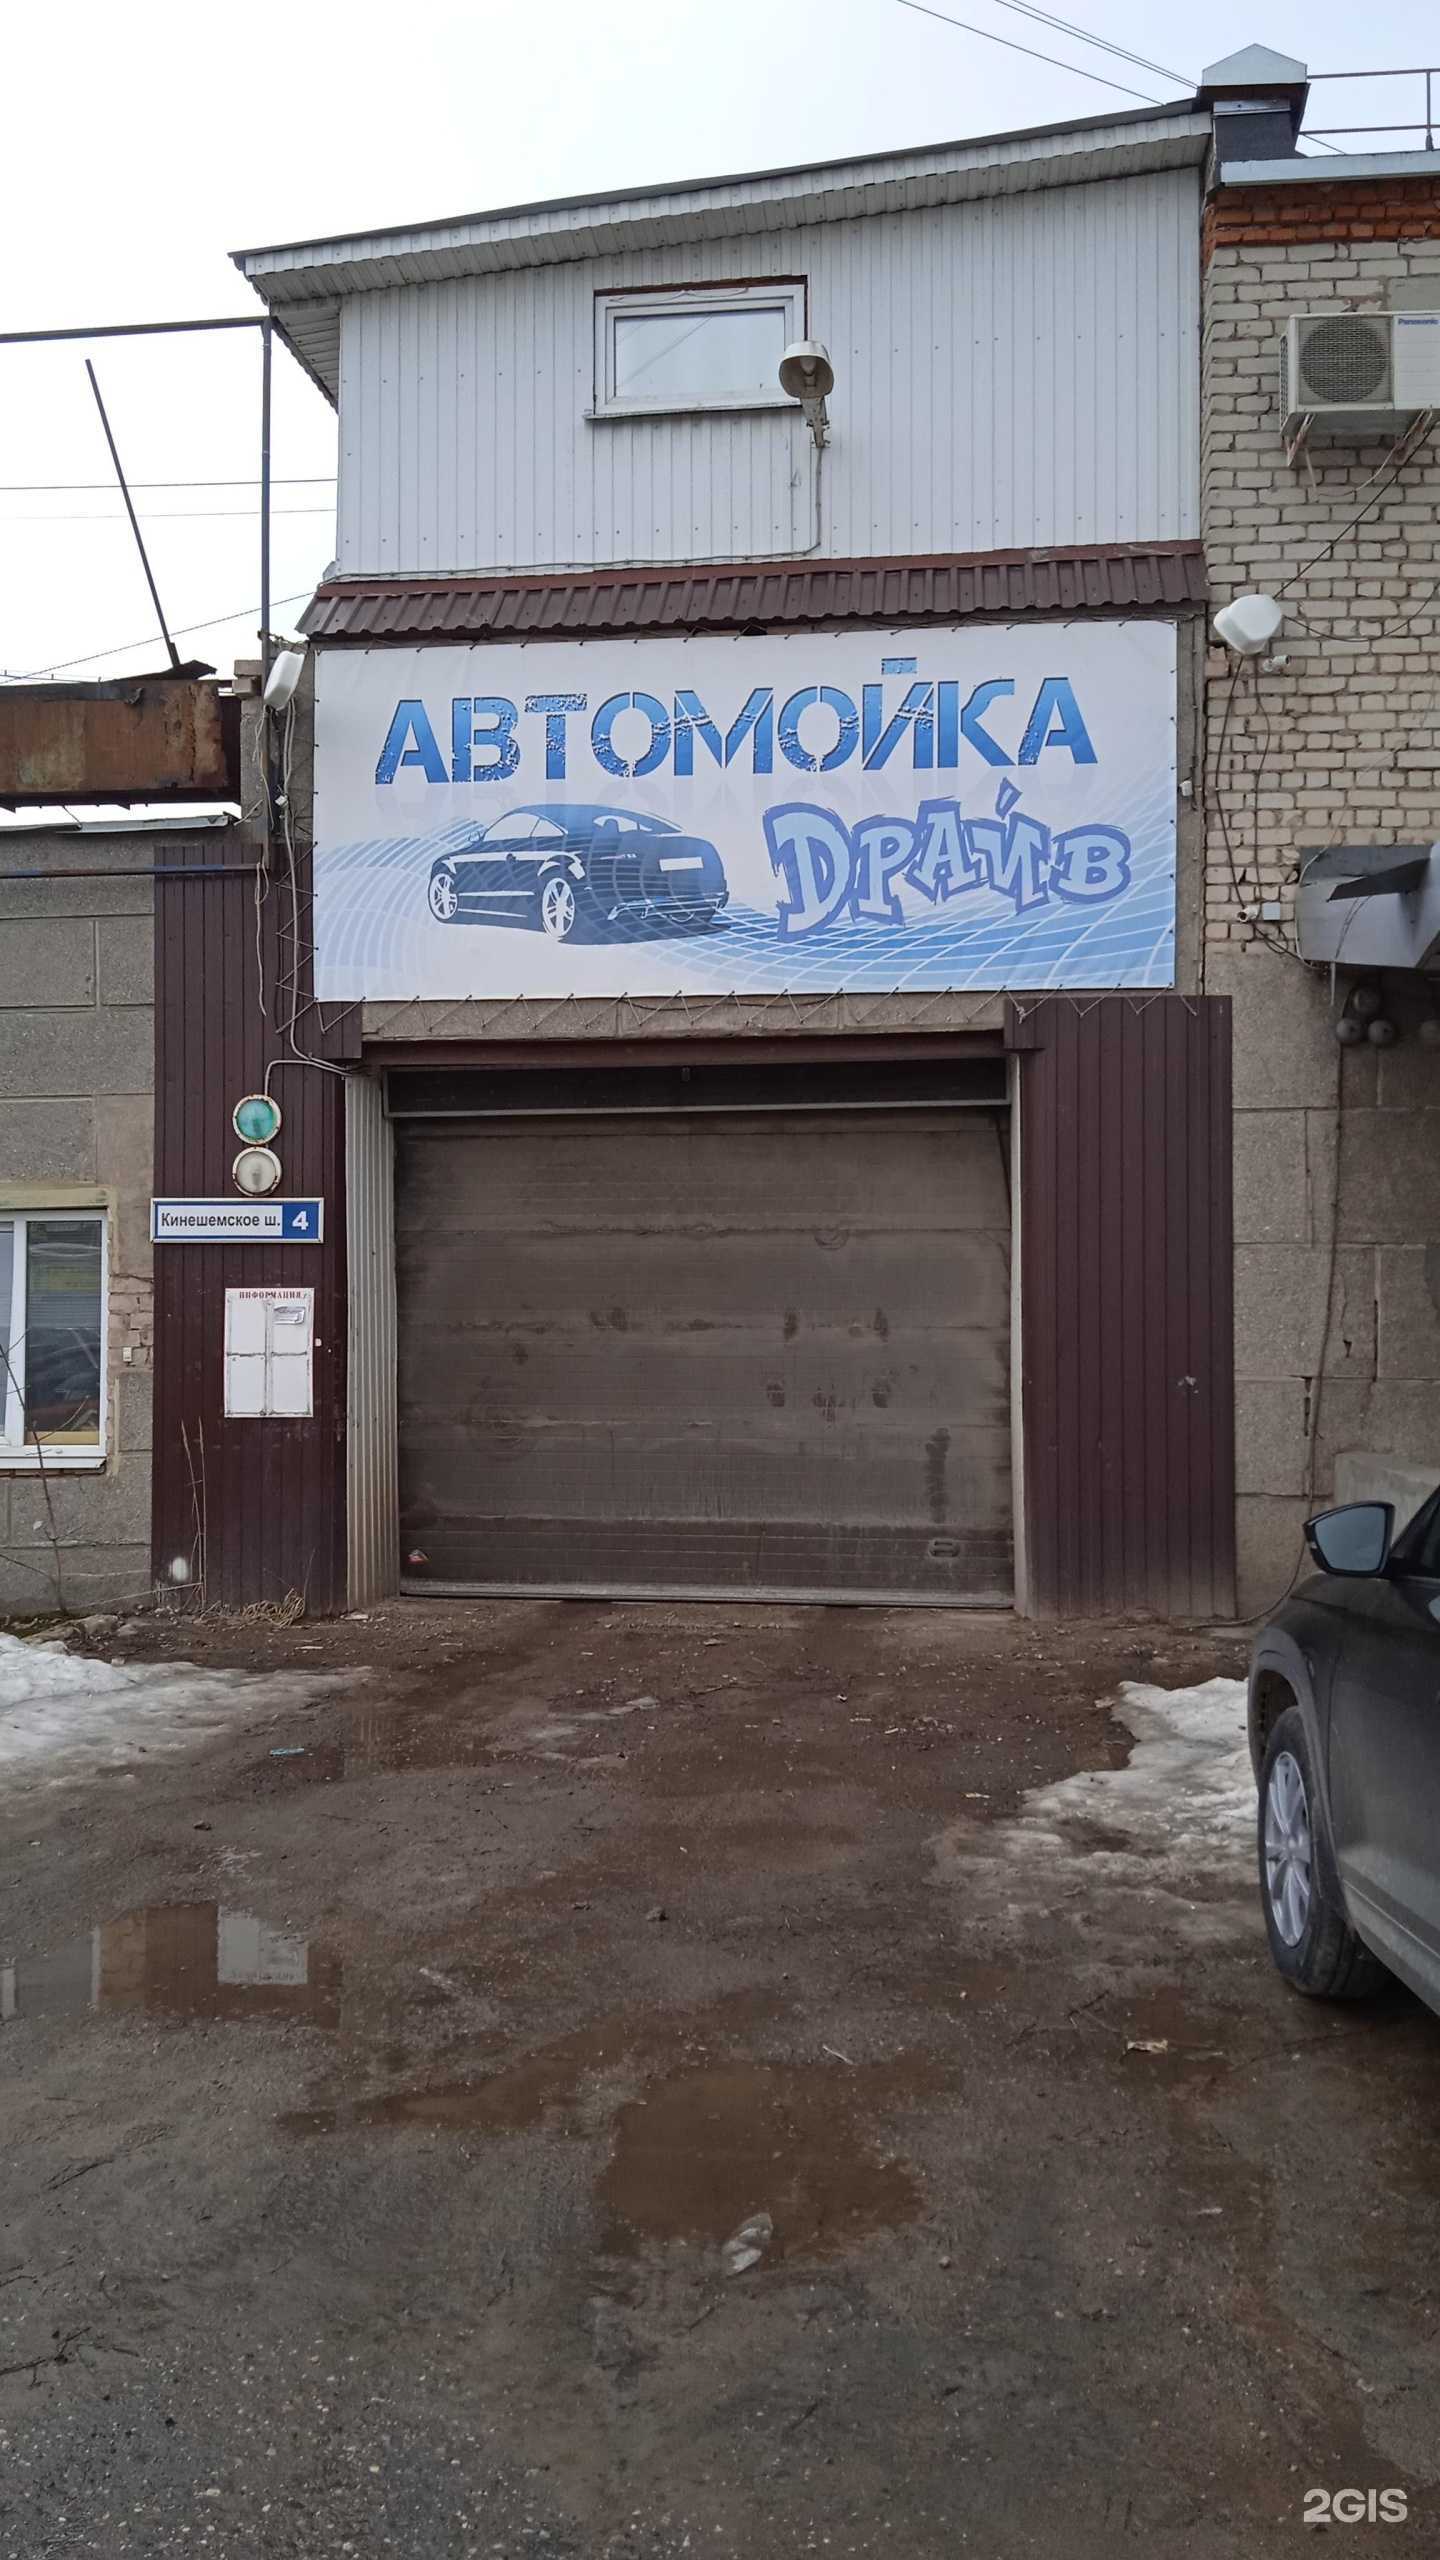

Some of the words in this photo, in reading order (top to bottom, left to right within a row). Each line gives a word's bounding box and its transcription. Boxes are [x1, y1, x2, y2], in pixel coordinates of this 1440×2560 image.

[375, 657, 1098, 785] АВТОМОЙКА
[161, 1212, 260, 1227] Кинешемское
[265, 1214, 281, 1227] ш.
[292, 1210, 309, 1230] 4
[239, 1291, 301, 1299] ИНФОРМАЦИЯ
